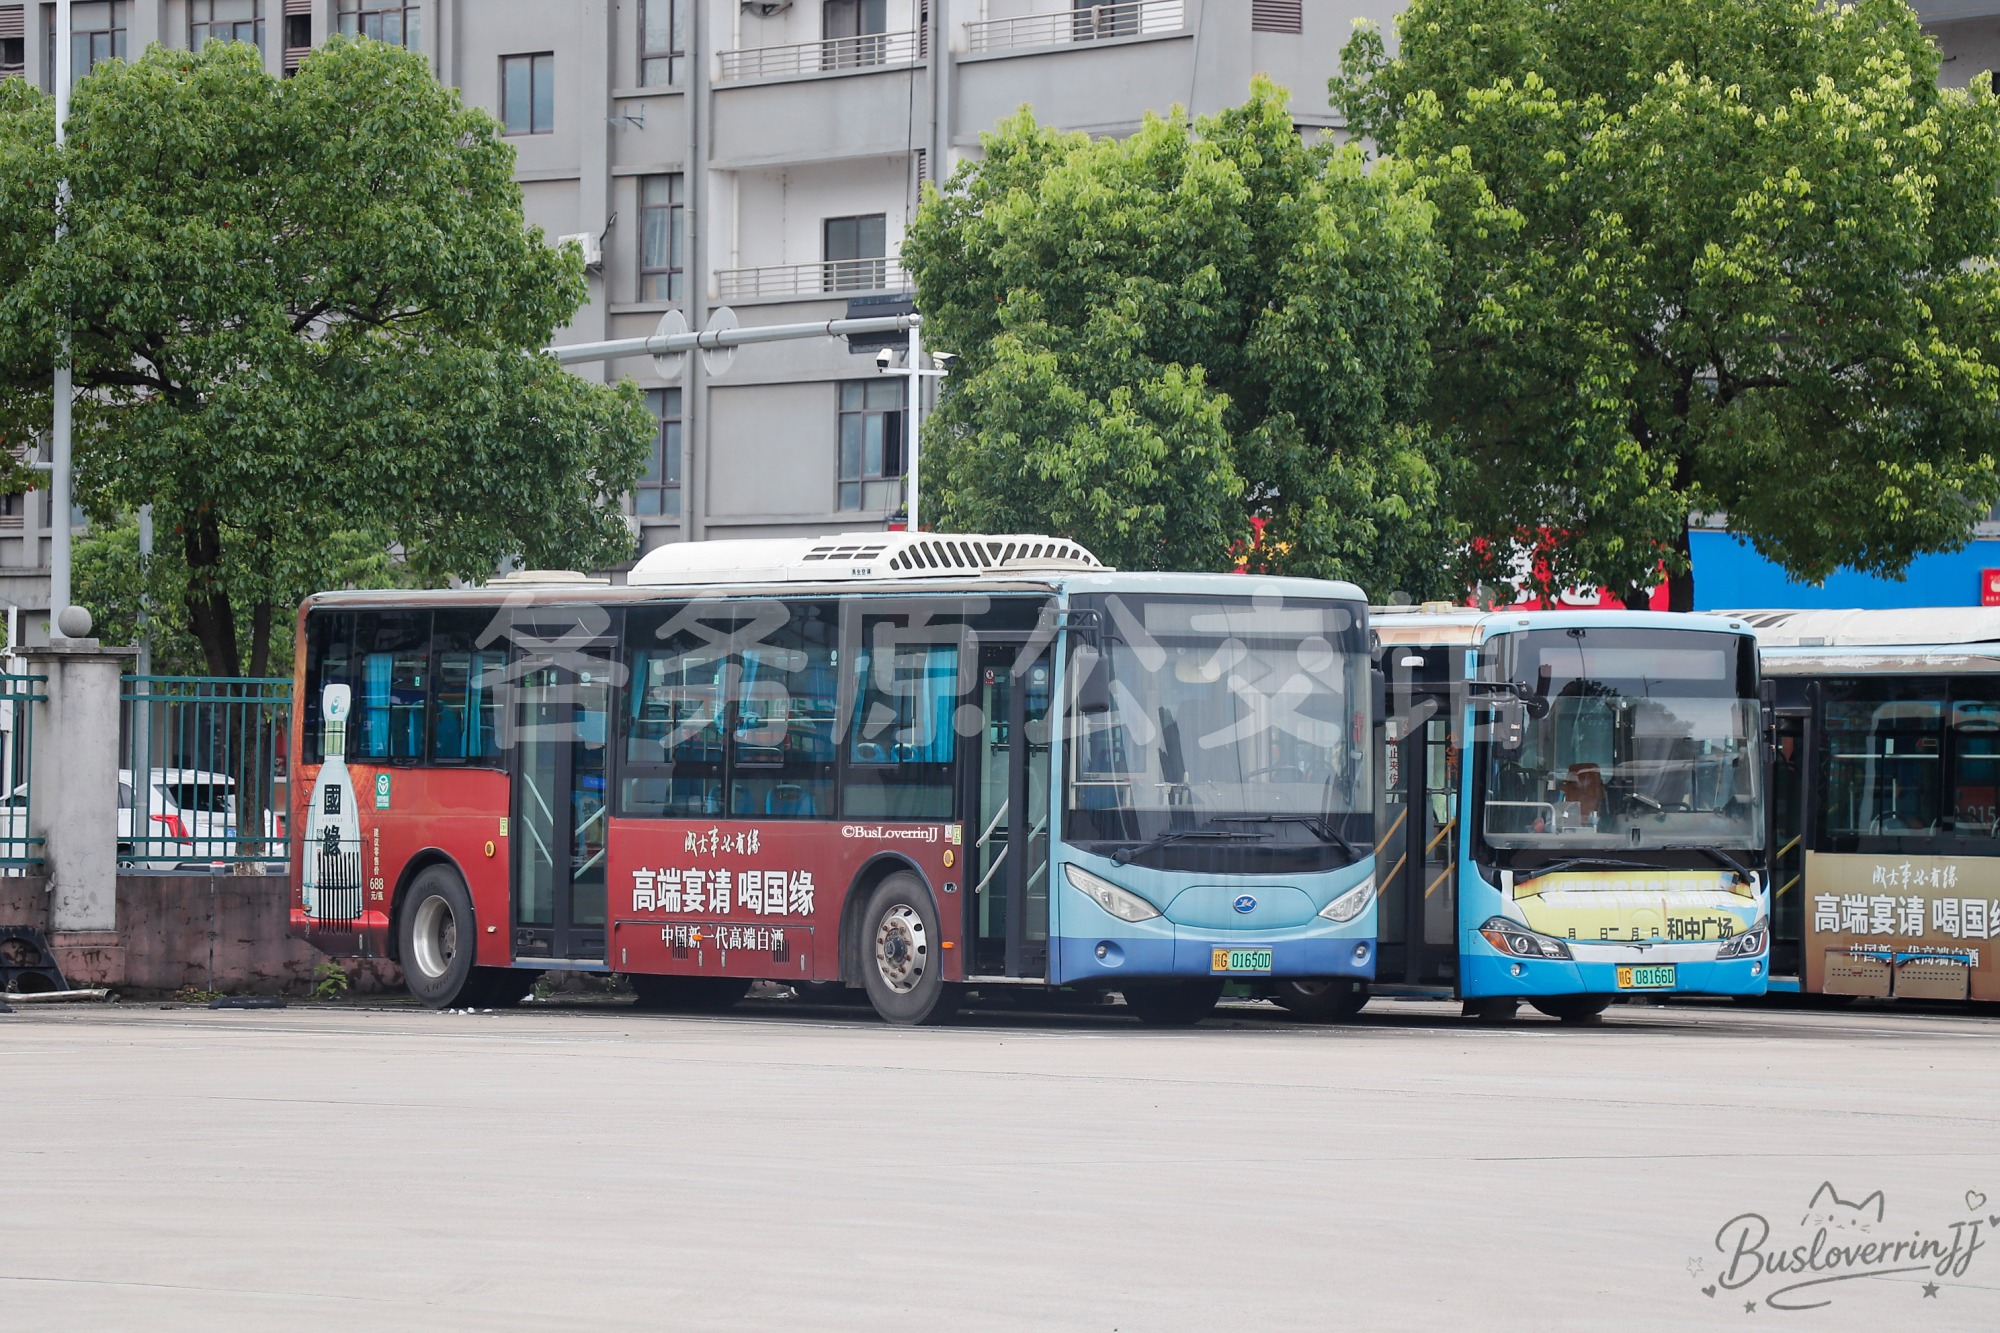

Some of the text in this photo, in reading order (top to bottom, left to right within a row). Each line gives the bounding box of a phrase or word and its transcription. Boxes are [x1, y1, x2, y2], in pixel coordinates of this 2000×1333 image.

[370, 878, 384, 890] 688
[632, 867, 815, 916] 高端宴请 喝国缘
[1814, 892, 1926, 937] 高端宴请
[661, 924, 784, 951] 中国新一代高端白酒
[1667, 917, 1733, 940] 和中广场
[1850, 943, 1979, 967] 中国新代高端白酒
